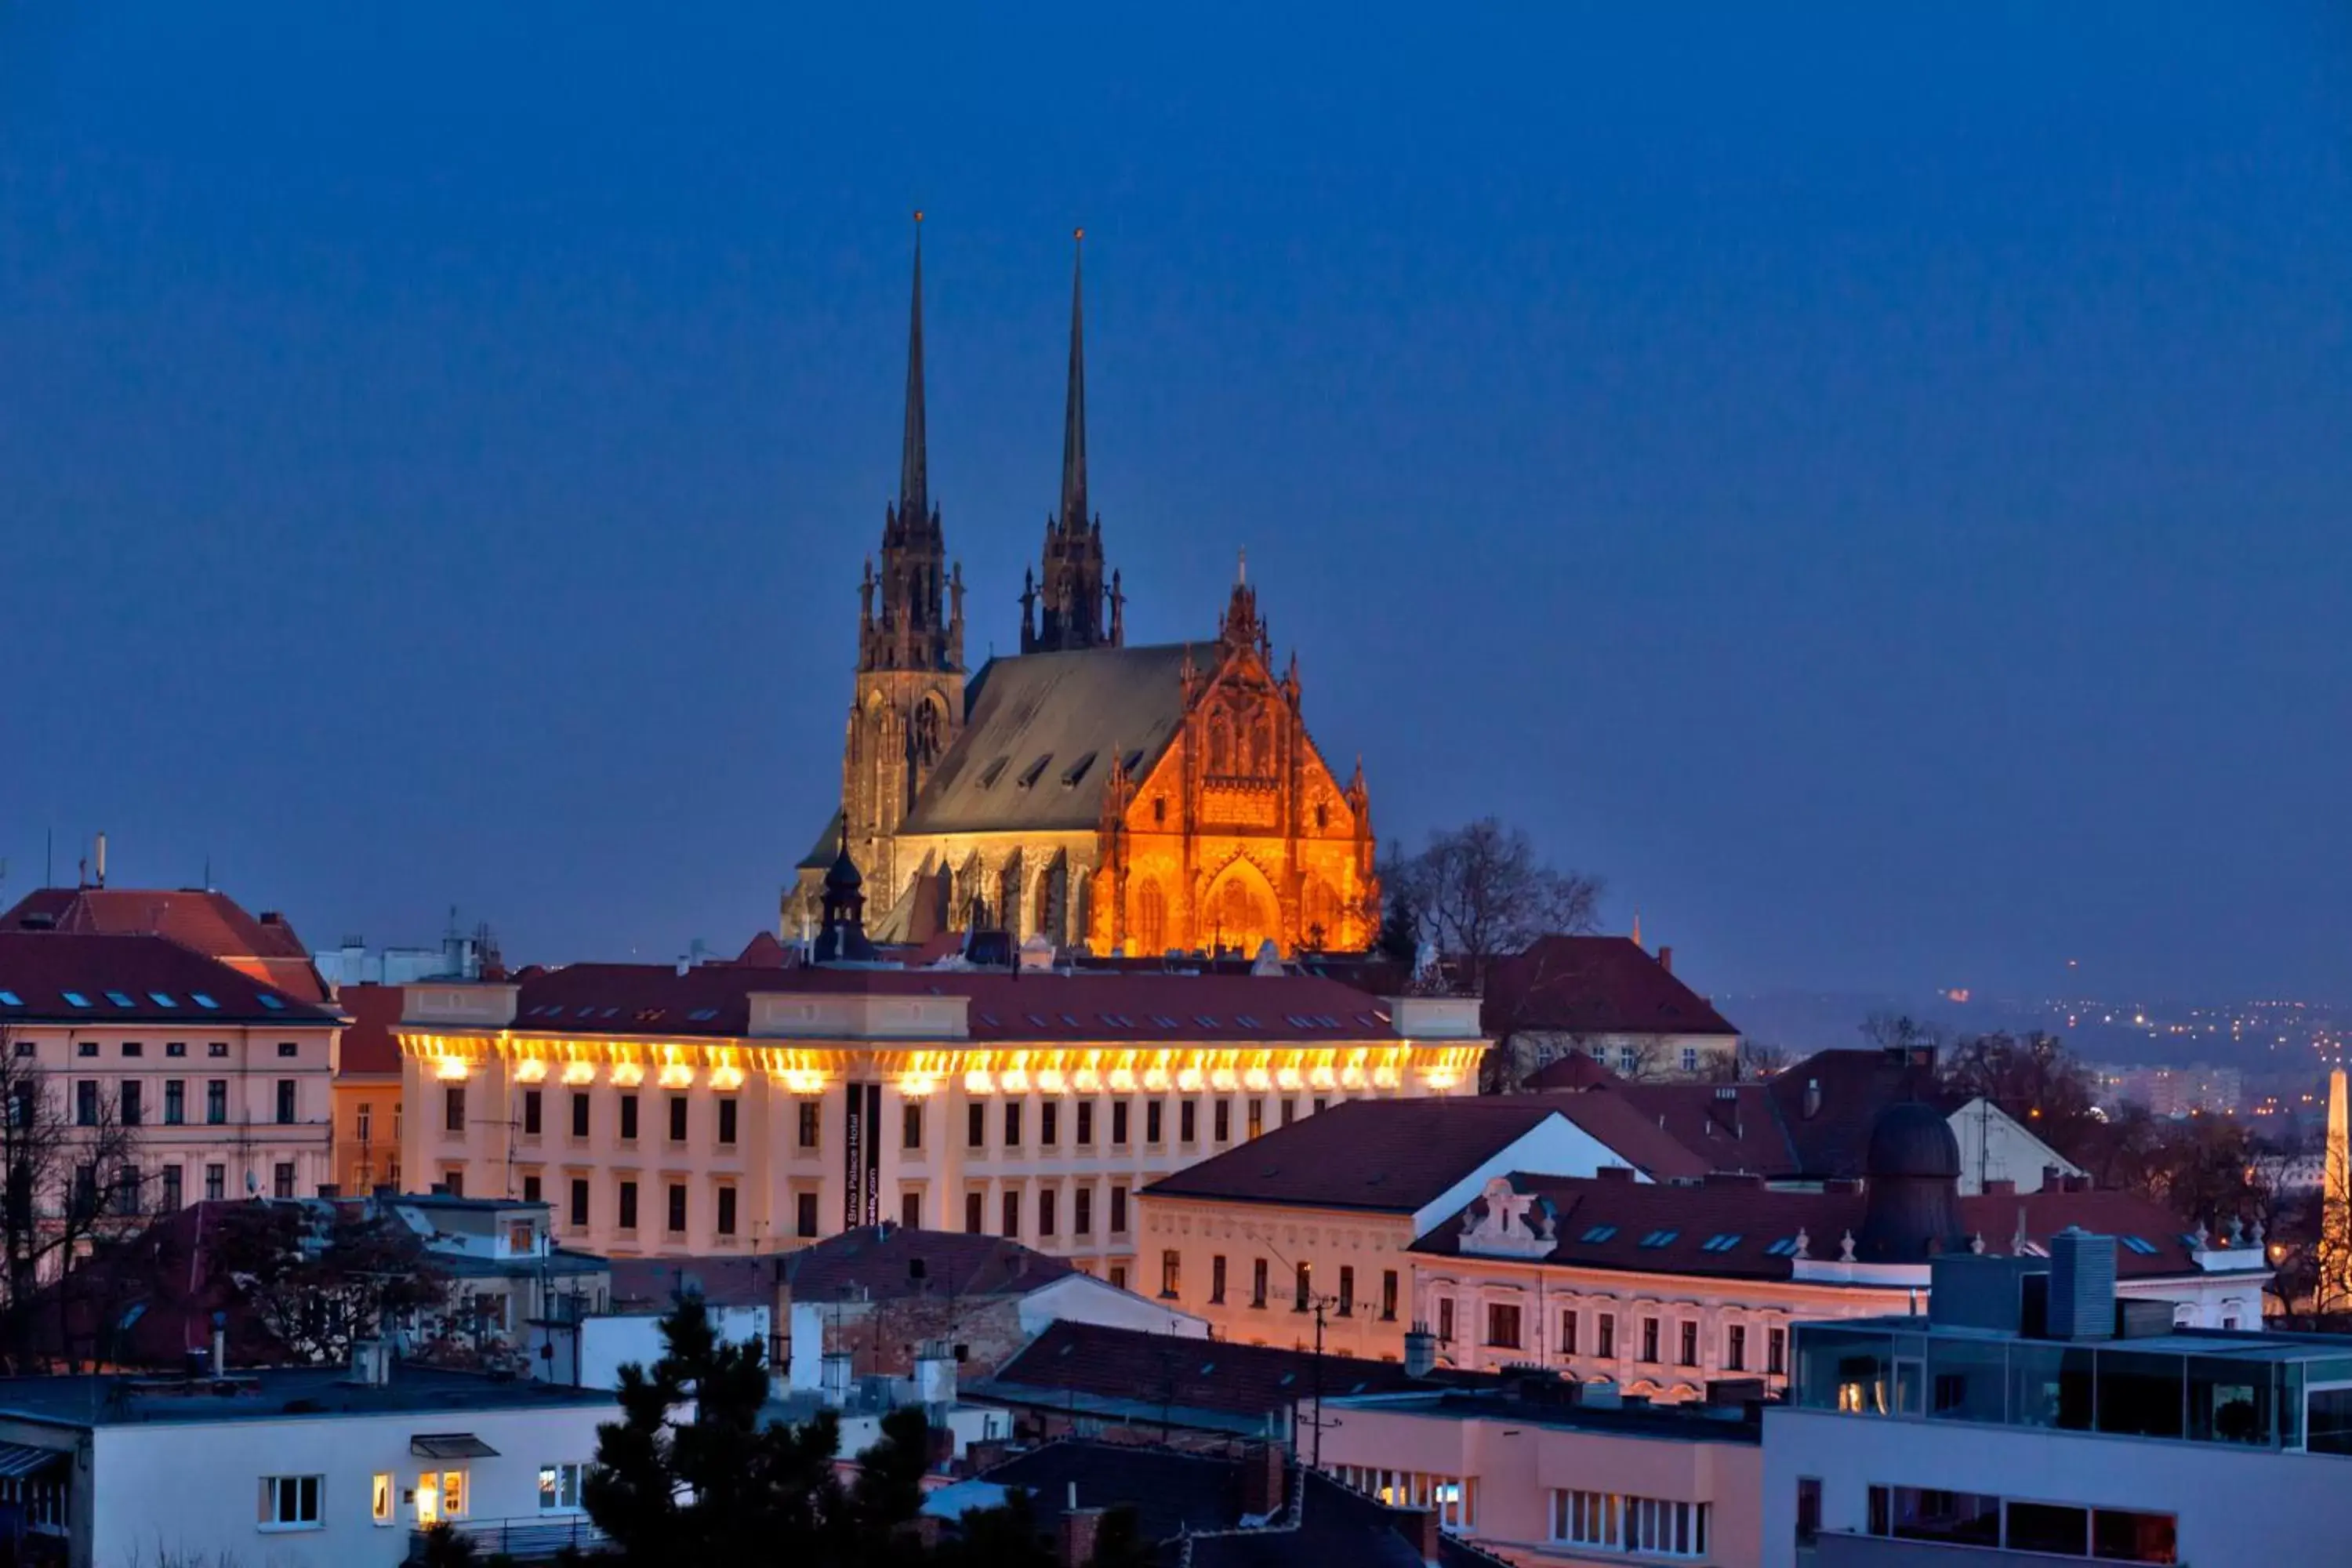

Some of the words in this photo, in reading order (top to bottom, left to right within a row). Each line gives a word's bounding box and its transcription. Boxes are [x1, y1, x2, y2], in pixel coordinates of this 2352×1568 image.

[849, 1114, 858, 1145] Hotel
[849, 1149, 858, 1189] Palace
[848, 1192, 858, 1221] Brno
